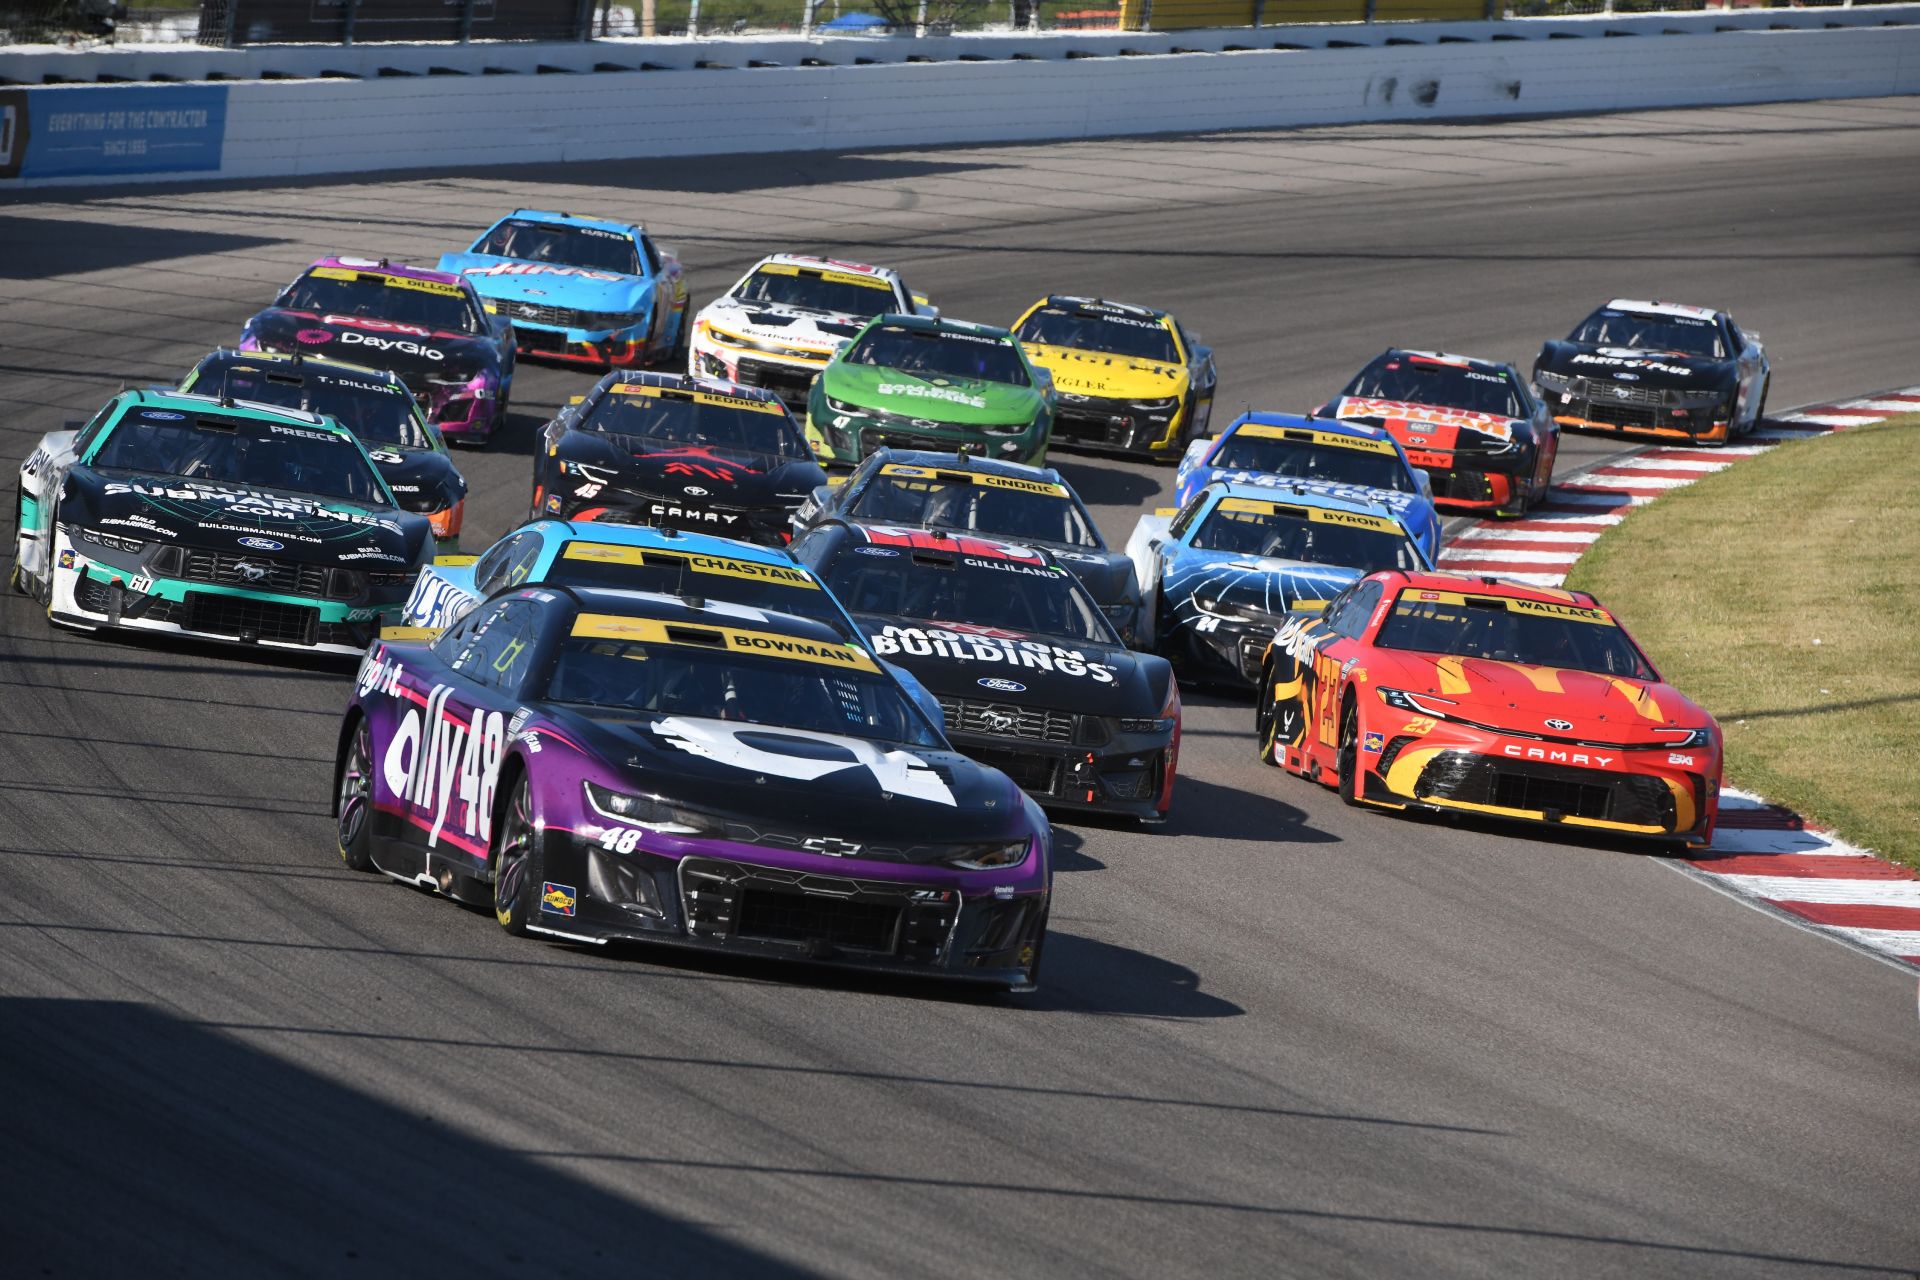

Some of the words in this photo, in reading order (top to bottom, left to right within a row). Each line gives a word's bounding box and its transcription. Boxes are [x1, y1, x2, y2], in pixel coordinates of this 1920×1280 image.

[48, 112, 104, 131] EVERYTHING
[106, 111, 125, 129] FOR
[128, 110, 145, 128] THE
[147, 109, 207, 129] CONTRACTOR
[581, 228, 625, 241] CUSTER
[388, 276, 403, 285] A.
[408, 280, 461, 294] DILLON
[341, 332, 444, 361] DayGlo
[318, 376, 333, 384] T.
[339, 379, 394, 395] DILLON
[1055, 376, 1105, 391] IGLER
[1465, 373, 1507, 384] JONES
[703, 394, 769, 410] REDDICK
[270, 425, 339, 443] PREECE
[1322, 435, 1380, 449] LARSON
[1408, 454, 1448, 464] MRY
[574, 483, 602, 498] 45
[985, 477, 1054, 494] CINDRIC
[104, 483, 404, 537] SUBMARINES
[128, 514, 157, 524] BUILD
[224, 504, 295, 520] .COM
[651, 504, 739, 524] CAMRY
[100, 518, 178, 538] SUBMARINES.COM
[1323, 512, 1382, 528] BYRON
[198, 522, 322, 544] BUILDSUBMARINES.COM
[692, 557, 807, 584] CHASTAIN
[964, 558, 1059, 579] GILLILAND
[128, 576, 153, 593] 60
[1516, 601, 1602, 620] WALLACE
[733, 635, 857, 662] BOWMAN
[883, 625, 1085, 662] MORTON
[1402, 717, 1437, 735] 23
[1504, 745, 1614, 767] CAMRY
[599, 826, 642, 855] 48
[544, 894, 574, 906] SUNOCO
[910, 890, 952, 902] ZL1
